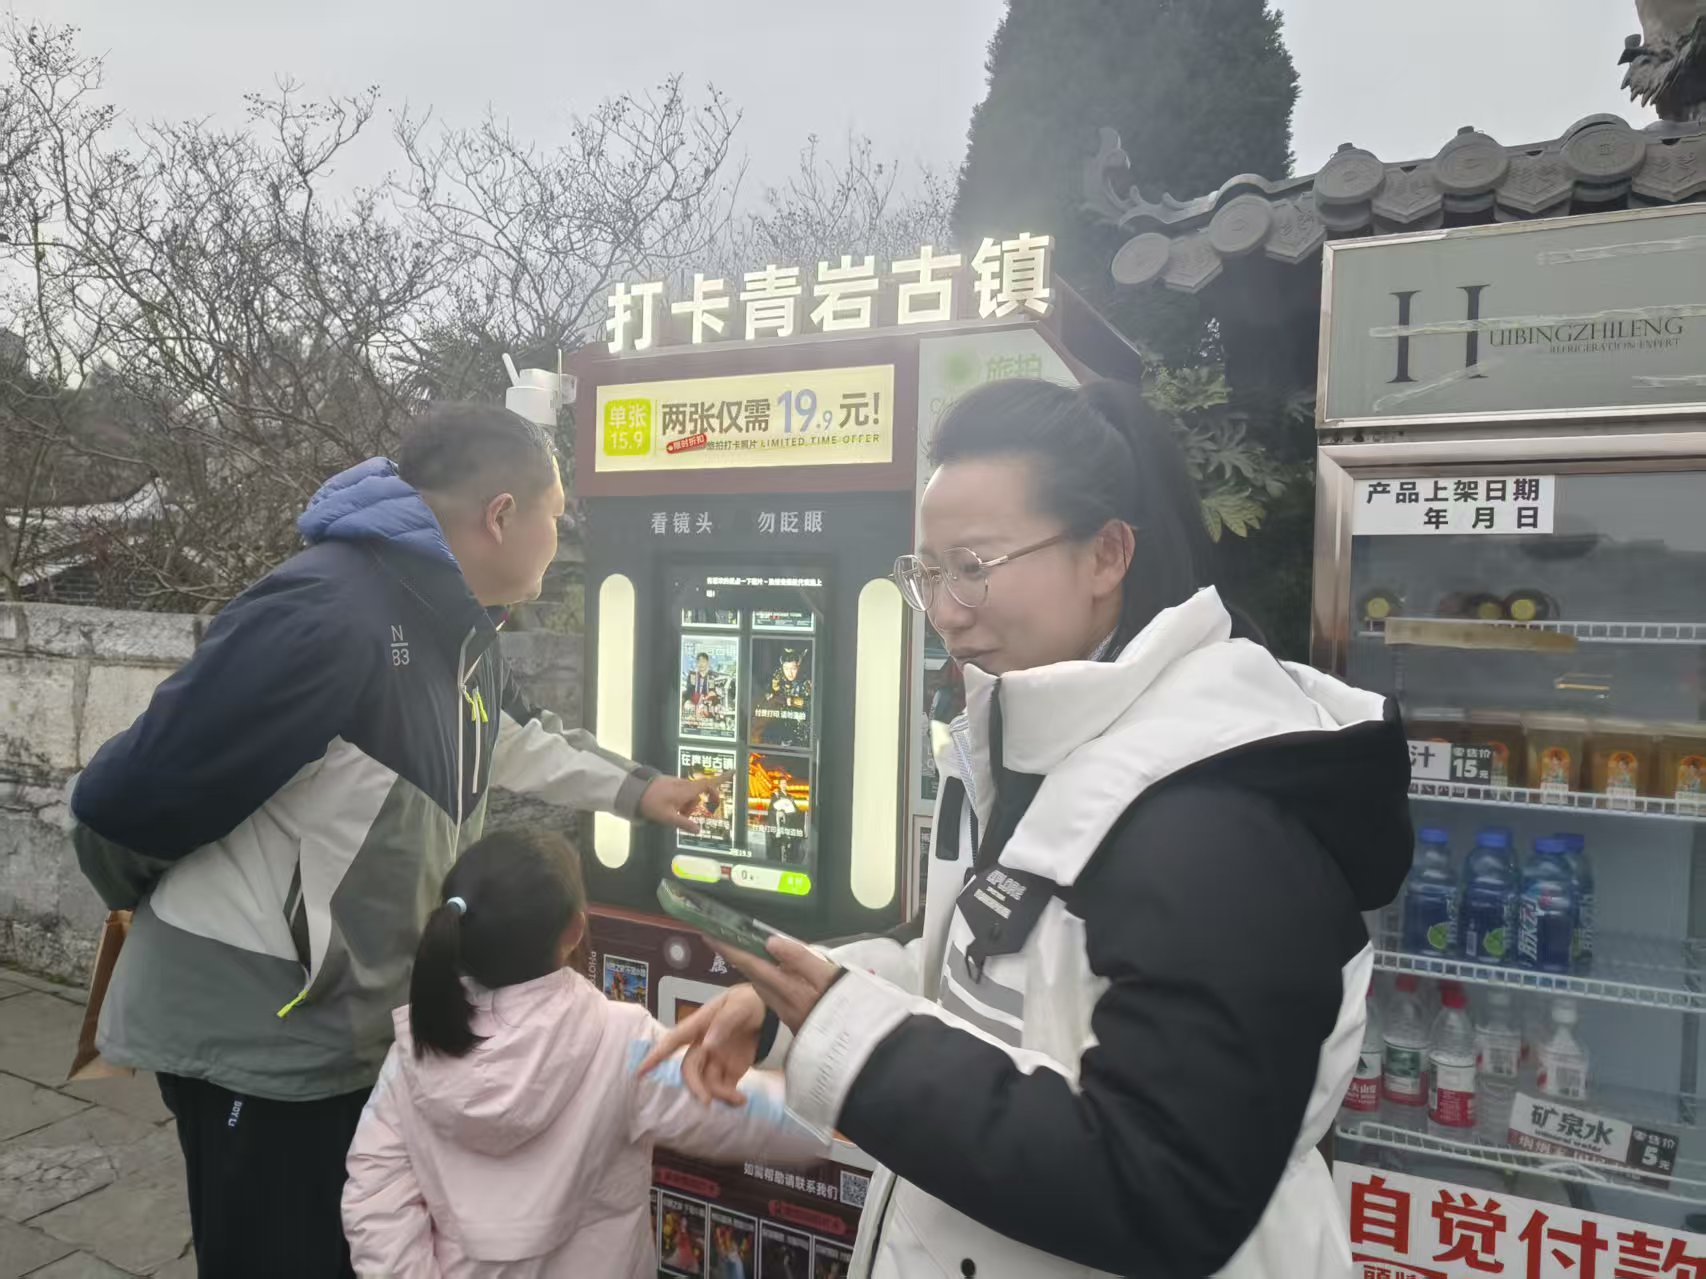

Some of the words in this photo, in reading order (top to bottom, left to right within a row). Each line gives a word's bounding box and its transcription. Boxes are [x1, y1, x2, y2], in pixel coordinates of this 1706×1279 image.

[607, 232, 1051, 353] 打卡青岩古镇
[609, 406, 647, 429] 单张
[610, 431, 644, 450] 15.9
[760, 437, 805, 448] LIMITED
[811, 435, 837, 445] TIME
[842, 433, 880, 444] OFFER
[1366, 478, 1540, 504] 产品上架日期
[651, 511, 713, 535] 看镜头
[758, 510, 824, 533] 勿眨眼
[1423, 507, 1448, 530] 年
[1472, 507, 1495, 529] 月
[1517, 507, 1539, 529] 日
[391, 624, 404, 641] N
[392, 648, 409, 666] 83
[1411, 744, 1436, 769] 汁
[1532, 1104, 1614, 1145] 矿泉水
